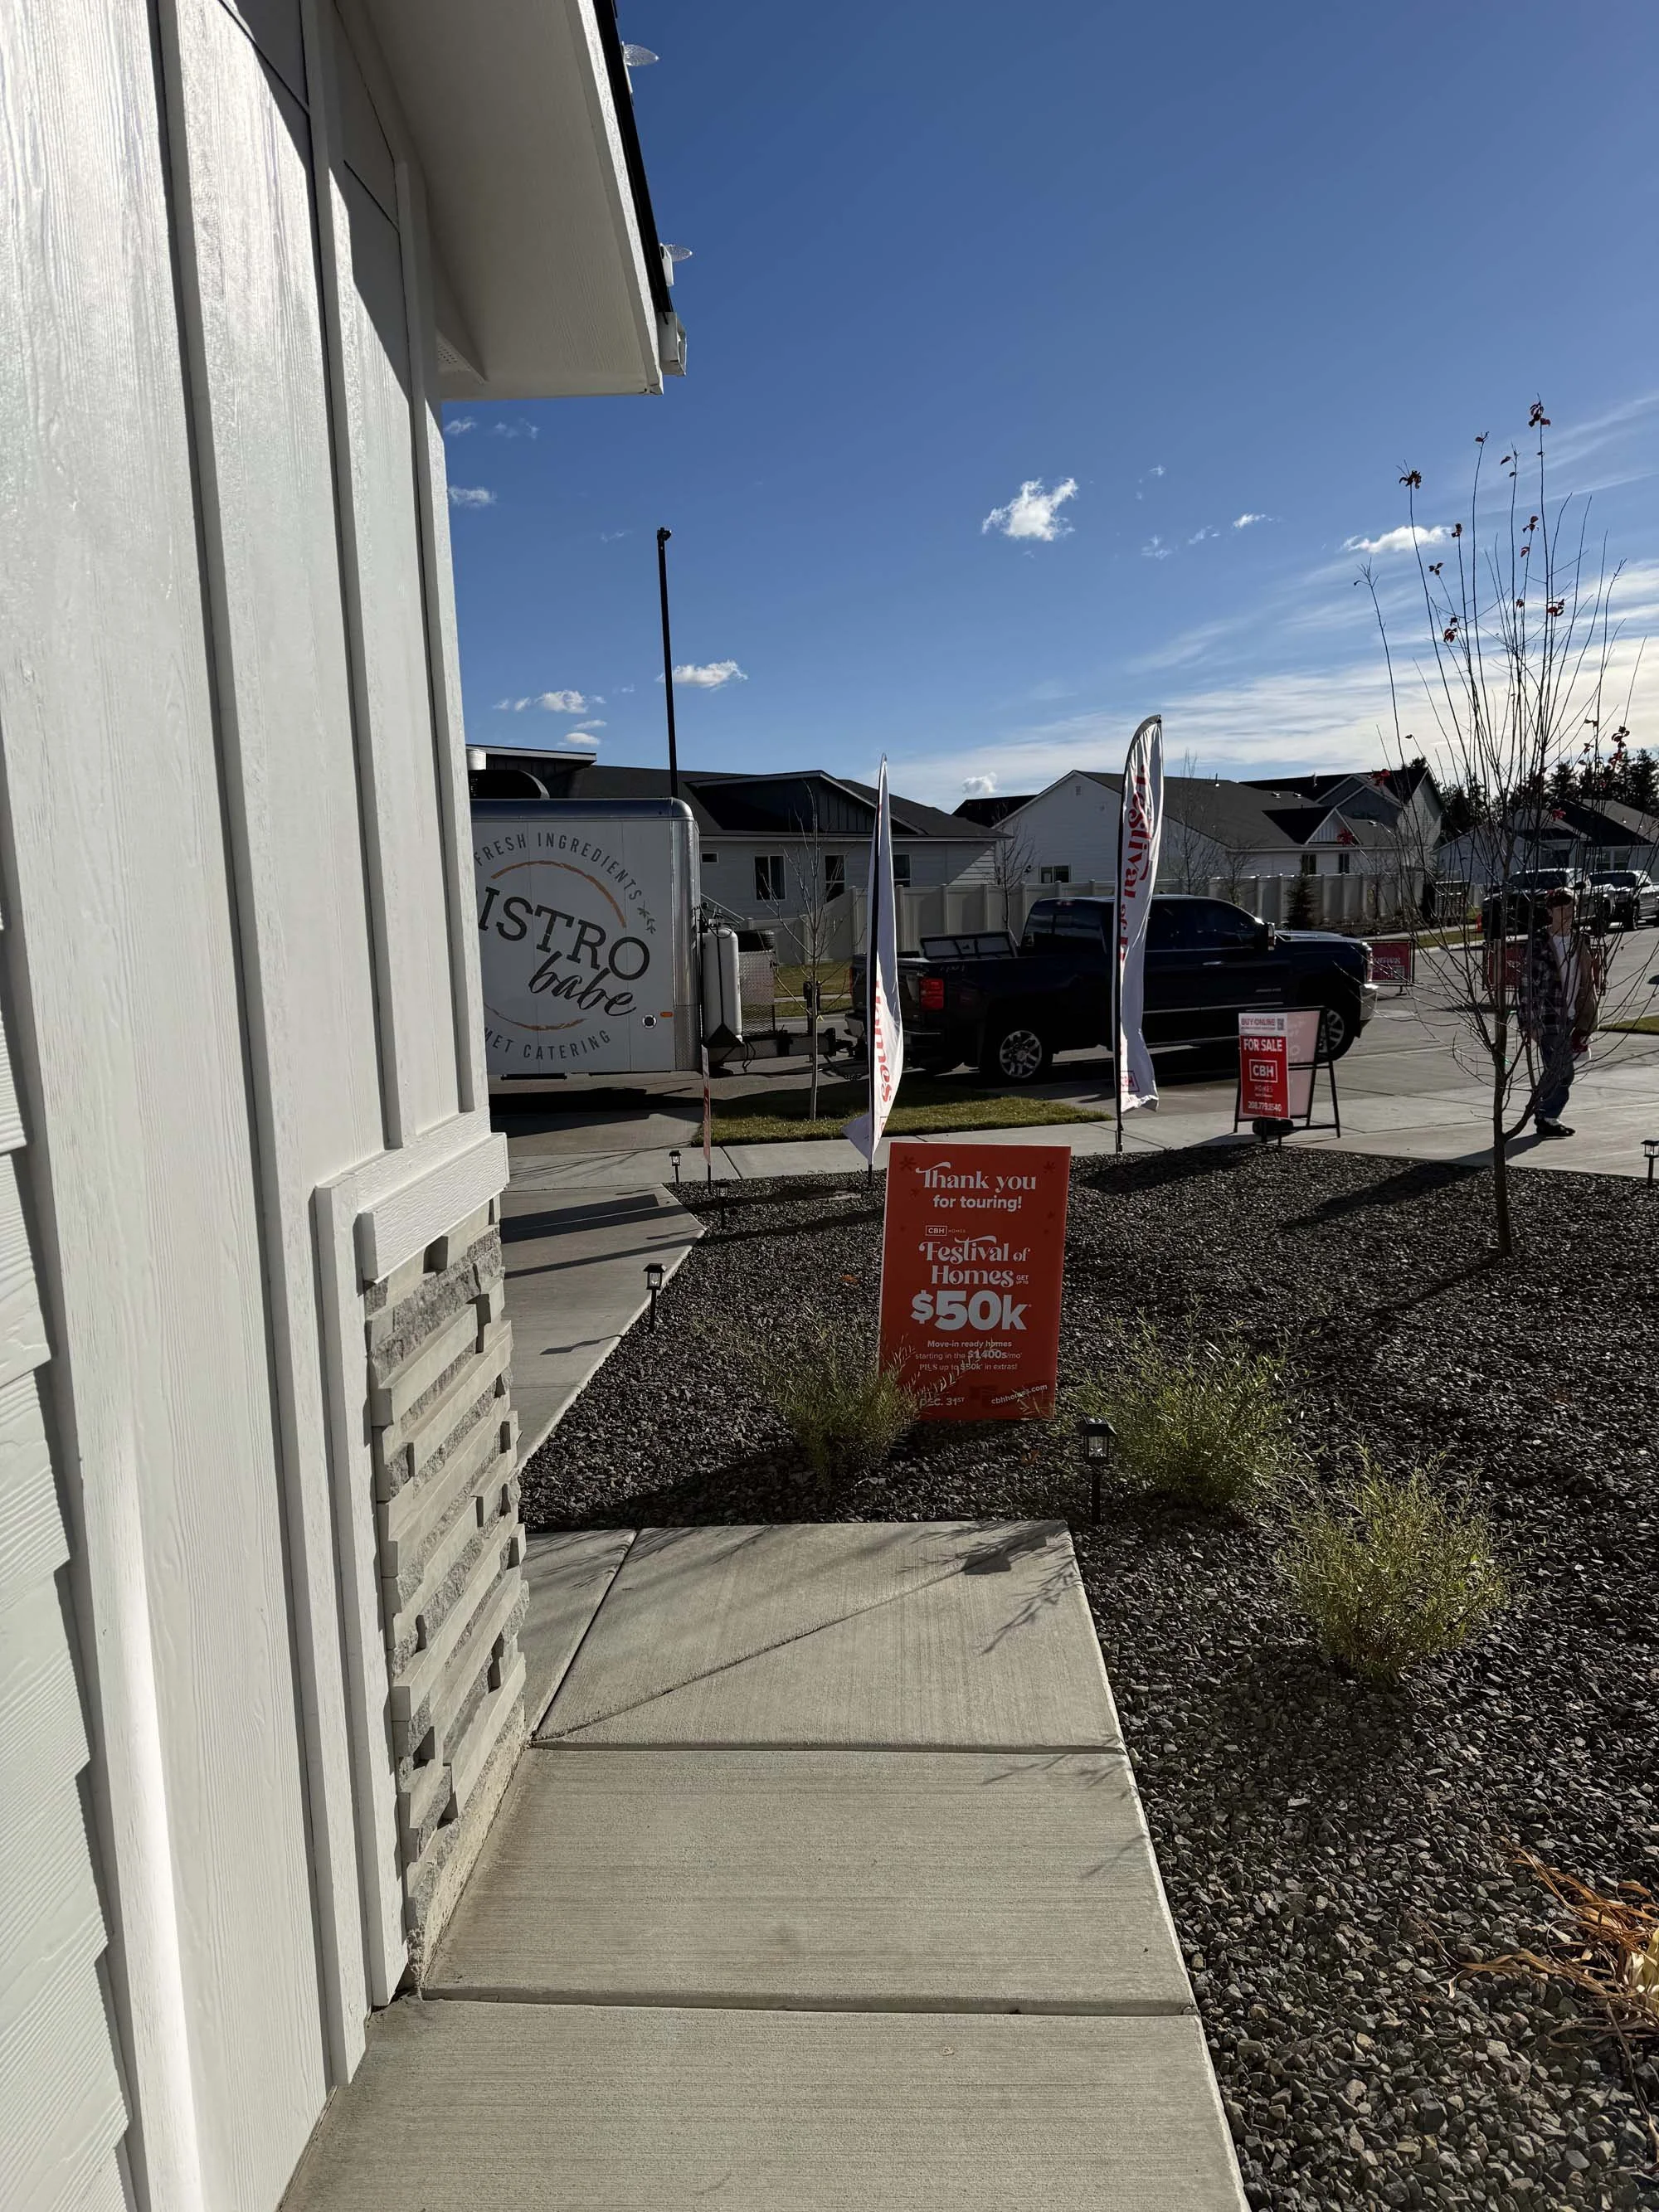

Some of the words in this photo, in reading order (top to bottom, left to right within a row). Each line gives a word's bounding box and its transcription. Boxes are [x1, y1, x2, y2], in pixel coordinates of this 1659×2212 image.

[474, 834, 526, 866] FRESH
[538, 832, 642, 901] INGREDIENTS
[476, 886, 650, 981] ISTRO
[528, 950, 637, 1017] babe
[484, 1027, 514, 1053] MET
[523, 1030, 611, 1060] CATERING
[1243, 1038, 1258, 1051] FOR
[1261, 1039, 1283, 1052] SALE
[1253, 1065, 1275, 1077] CBH
[915, 1161, 990, 1189] Thank
[995, 1175, 1036, 1193] you
[933, 1194, 956, 1208] for
[961, 1195, 1022, 1212] touring!
[918, 1235, 1010, 1265] Festival
[1013, 1247, 1031, 1262] of
[931, 1265, 1014, 1288] Homes
[927, 1339, 960, 1348] Move-in
[961, 1339, 984, 1349] ready
[985, 1339, 1012, 1348] homes
